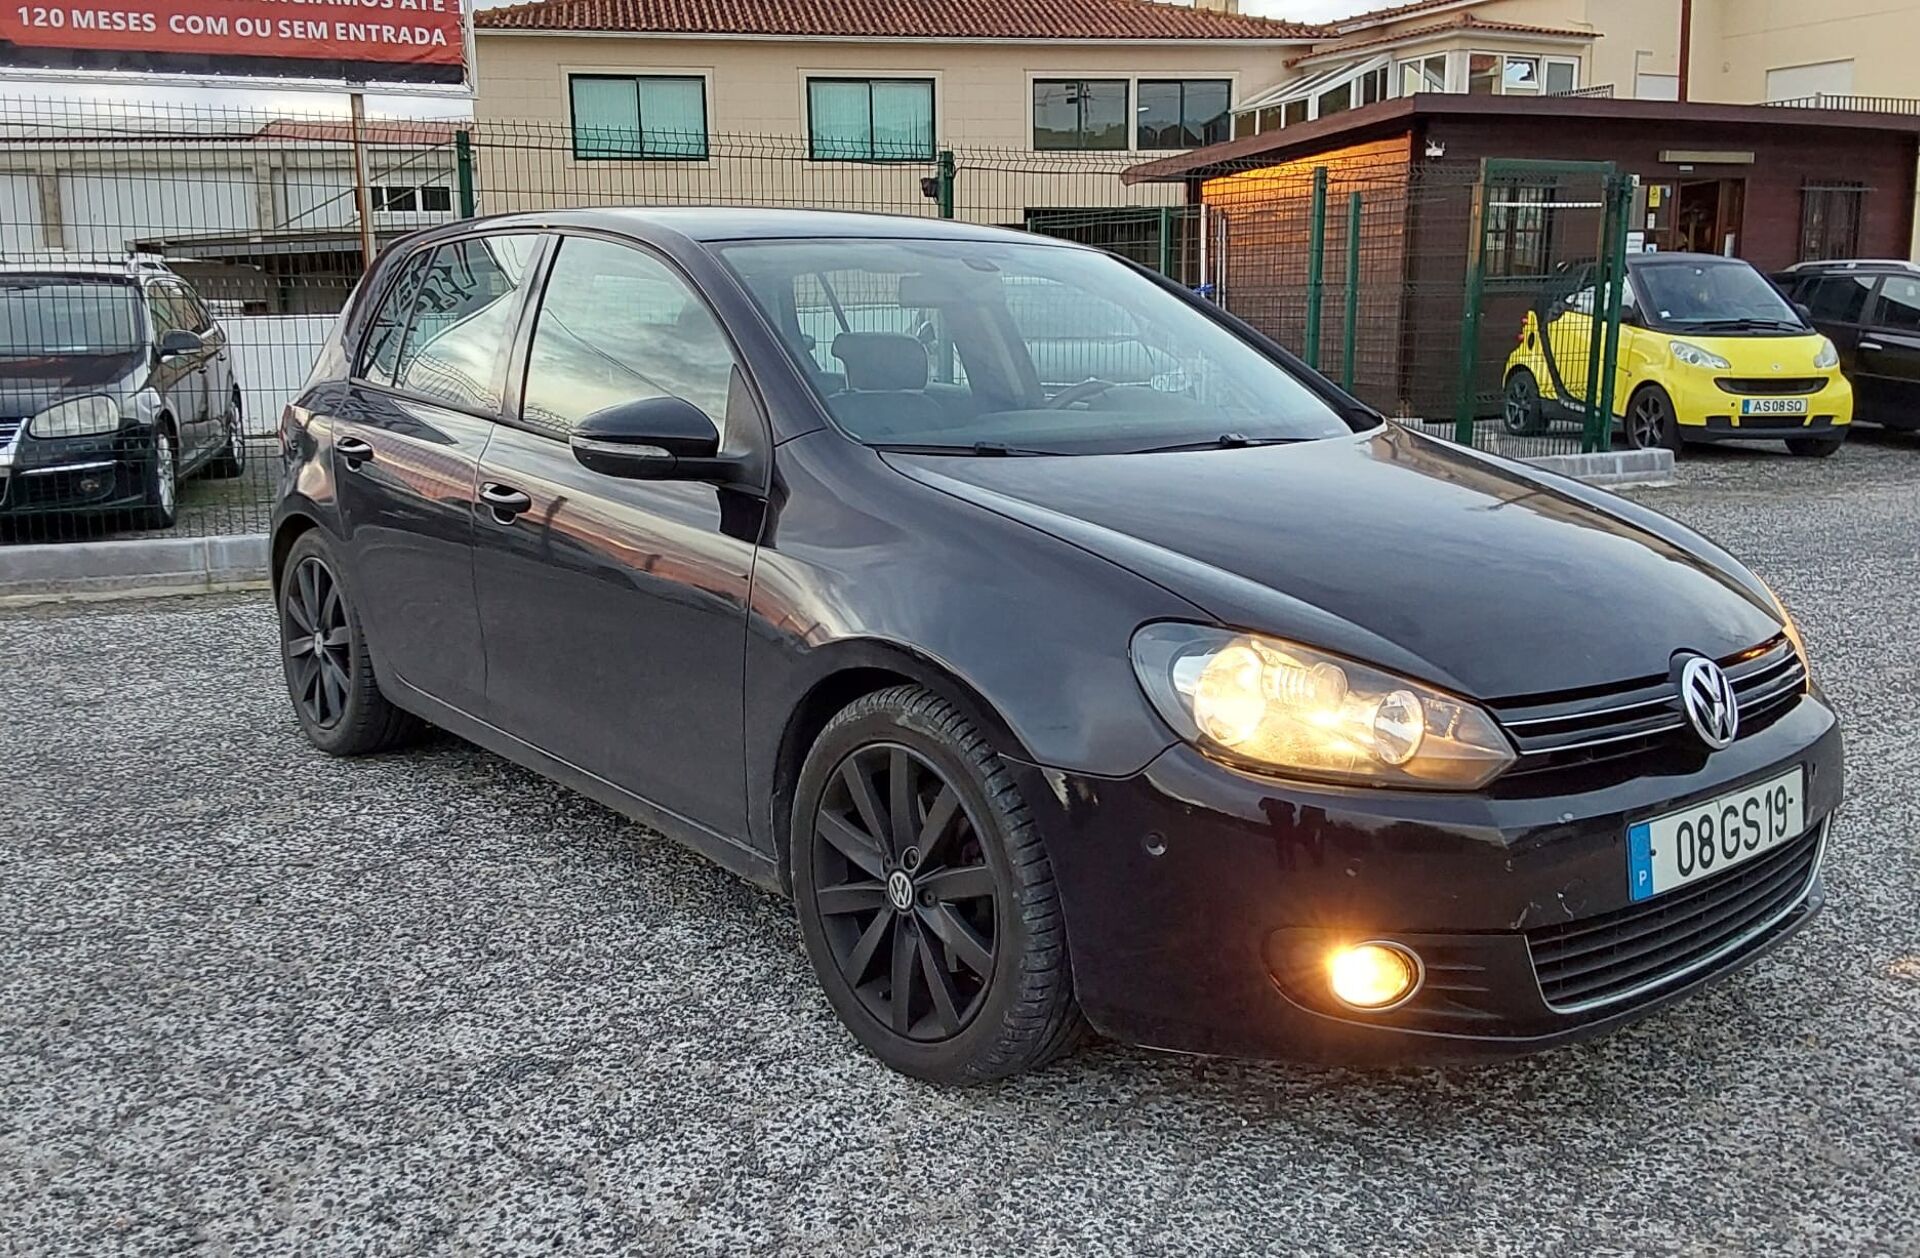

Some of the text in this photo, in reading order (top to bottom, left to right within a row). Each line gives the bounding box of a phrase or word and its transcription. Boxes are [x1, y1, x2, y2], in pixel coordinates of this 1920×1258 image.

[17, 6, 448, 46] 120 MESES COM OU SEM ENTRADA
[1638, 870, 1648, 887] P
